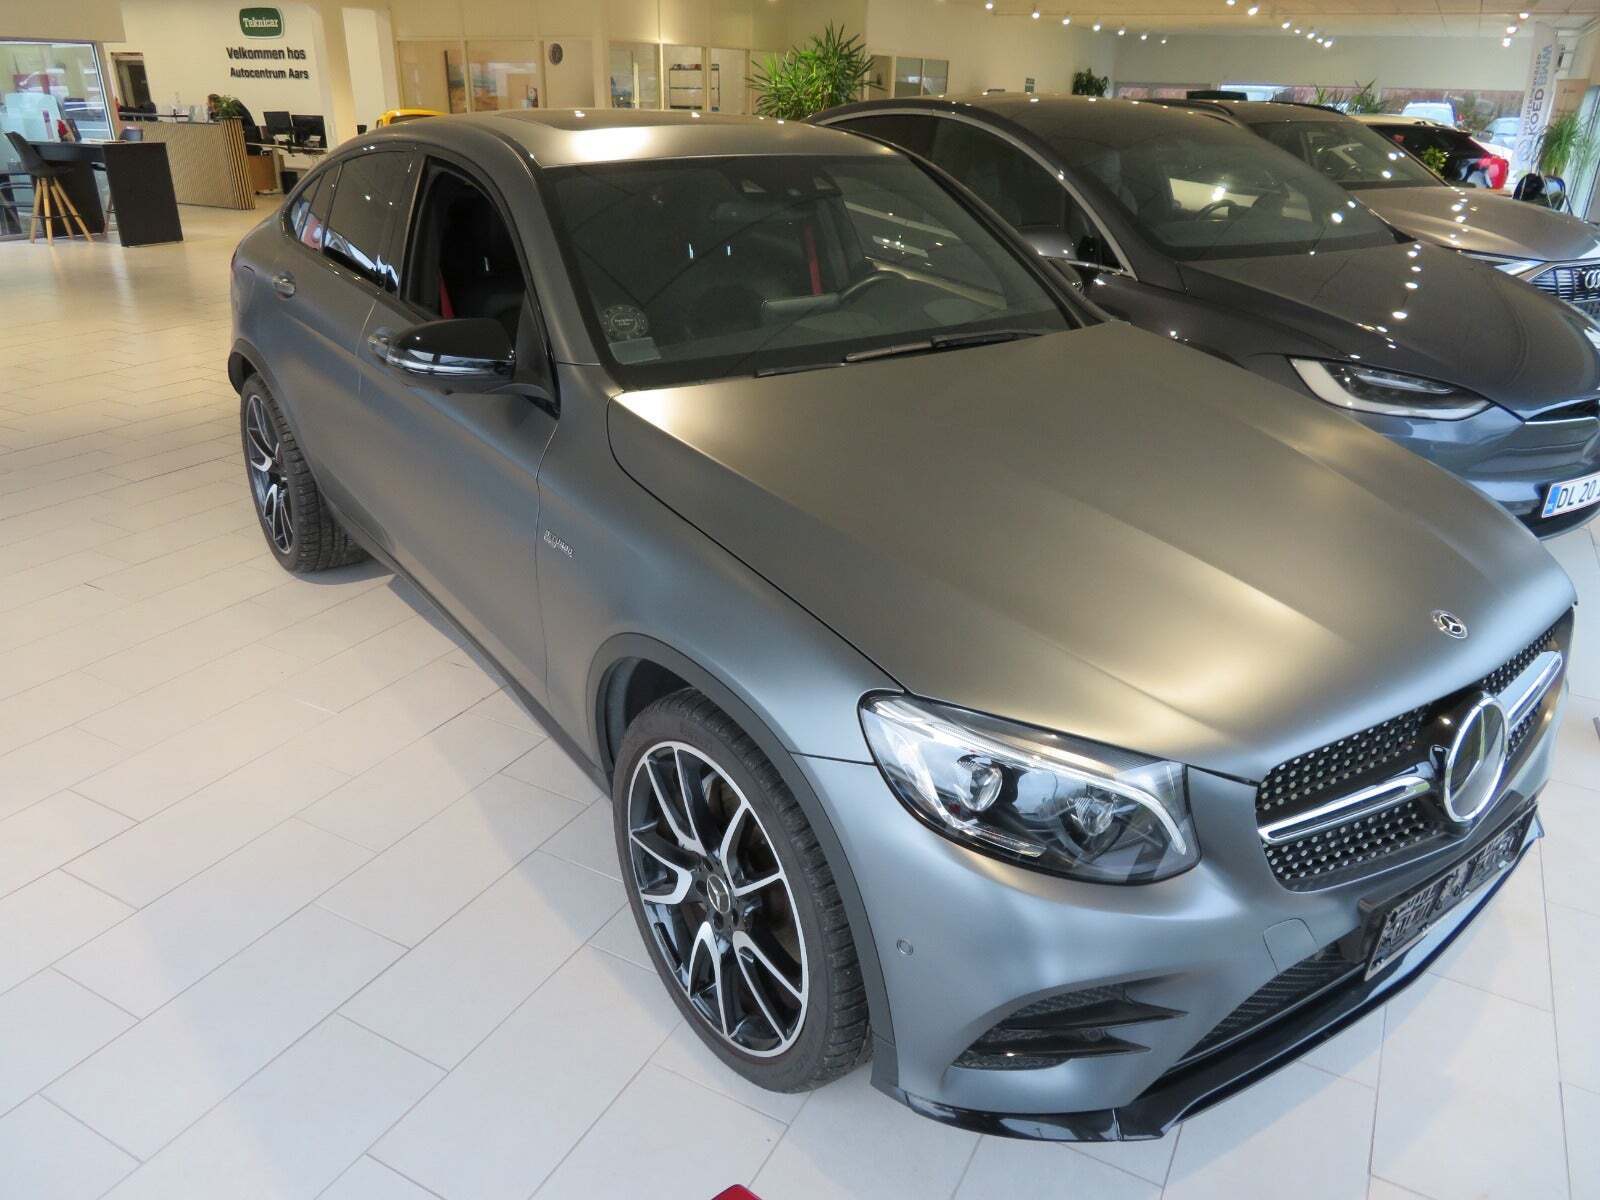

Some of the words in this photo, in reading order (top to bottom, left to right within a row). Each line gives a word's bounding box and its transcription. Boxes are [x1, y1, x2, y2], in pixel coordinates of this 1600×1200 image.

[243, 17, 279, 28] Teknicar
[226, 47, 285, 60] Velkommen
[286, 46, 306, 60] hos
[230, 67, 286, 79] Autocentrum
[288, 68, 309, 80] Aars
[1556, 485, 1576, 508] DL
[1579, 480, 1597, 503] 20
